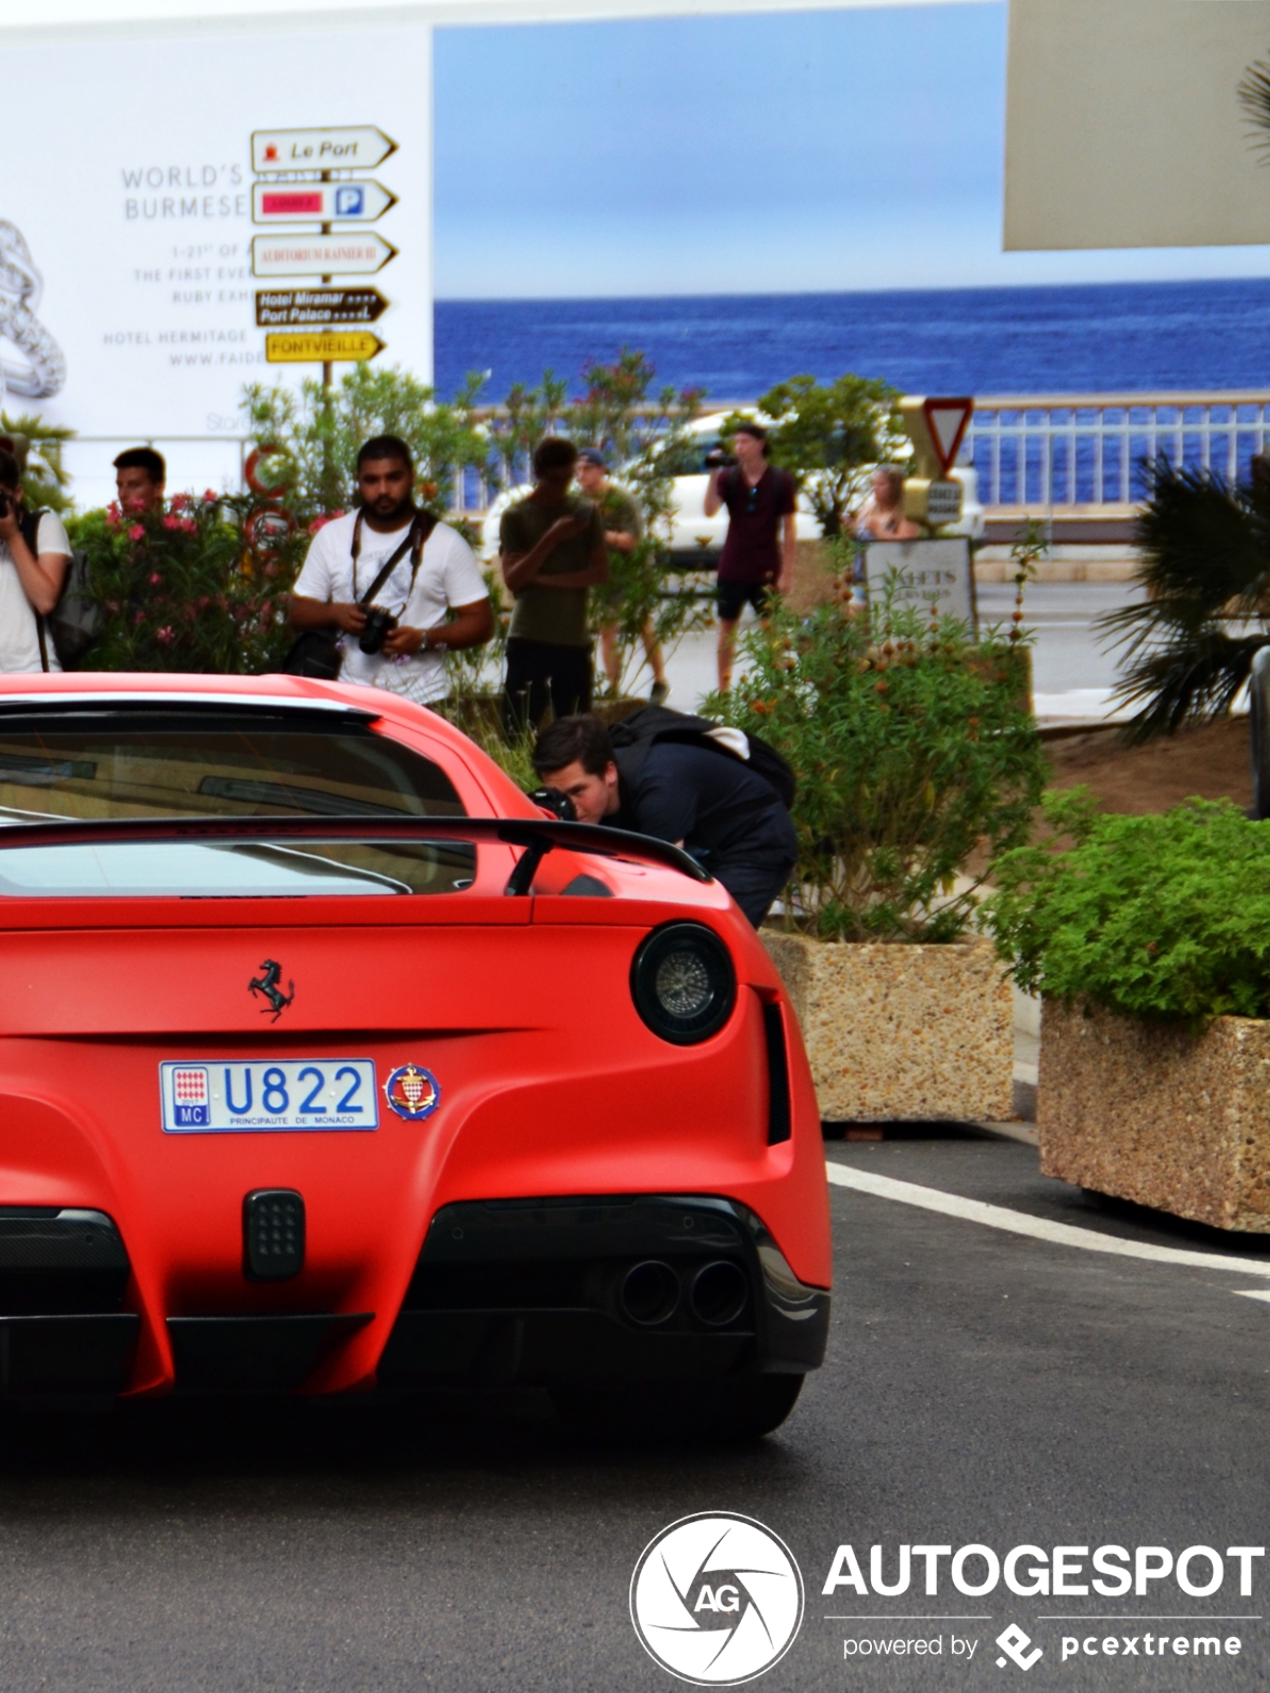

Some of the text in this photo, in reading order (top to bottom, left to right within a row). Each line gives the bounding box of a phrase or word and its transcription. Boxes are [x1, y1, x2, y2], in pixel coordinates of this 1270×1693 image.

[290, 141, 358, 159] Le Port
[121, 163, 243, 189] WORLD'S
[125, 194, 247, 219] BURMESE
[218, 243, 239, 258] OF
[133, 268, 162, 282] THE
[168, 267, 212, 281] FIRST
[172, 289, 213, 303] RUBY
[260, 290, 345, 306] Hotel Miramar
[260, 308, 288, 323] Port
[290, 307, 331, 322] Palace
[103, 328, 247, 345] HOTEL HERMITAGE
[272, 337, 368, 354] FONTVIEILLE
[224, 1066, 364, 1115] U822
[181, 1107, 202, 1123] MC
[230, 1115, 355, 1126] PRINCIPAUTE DE MONACO
